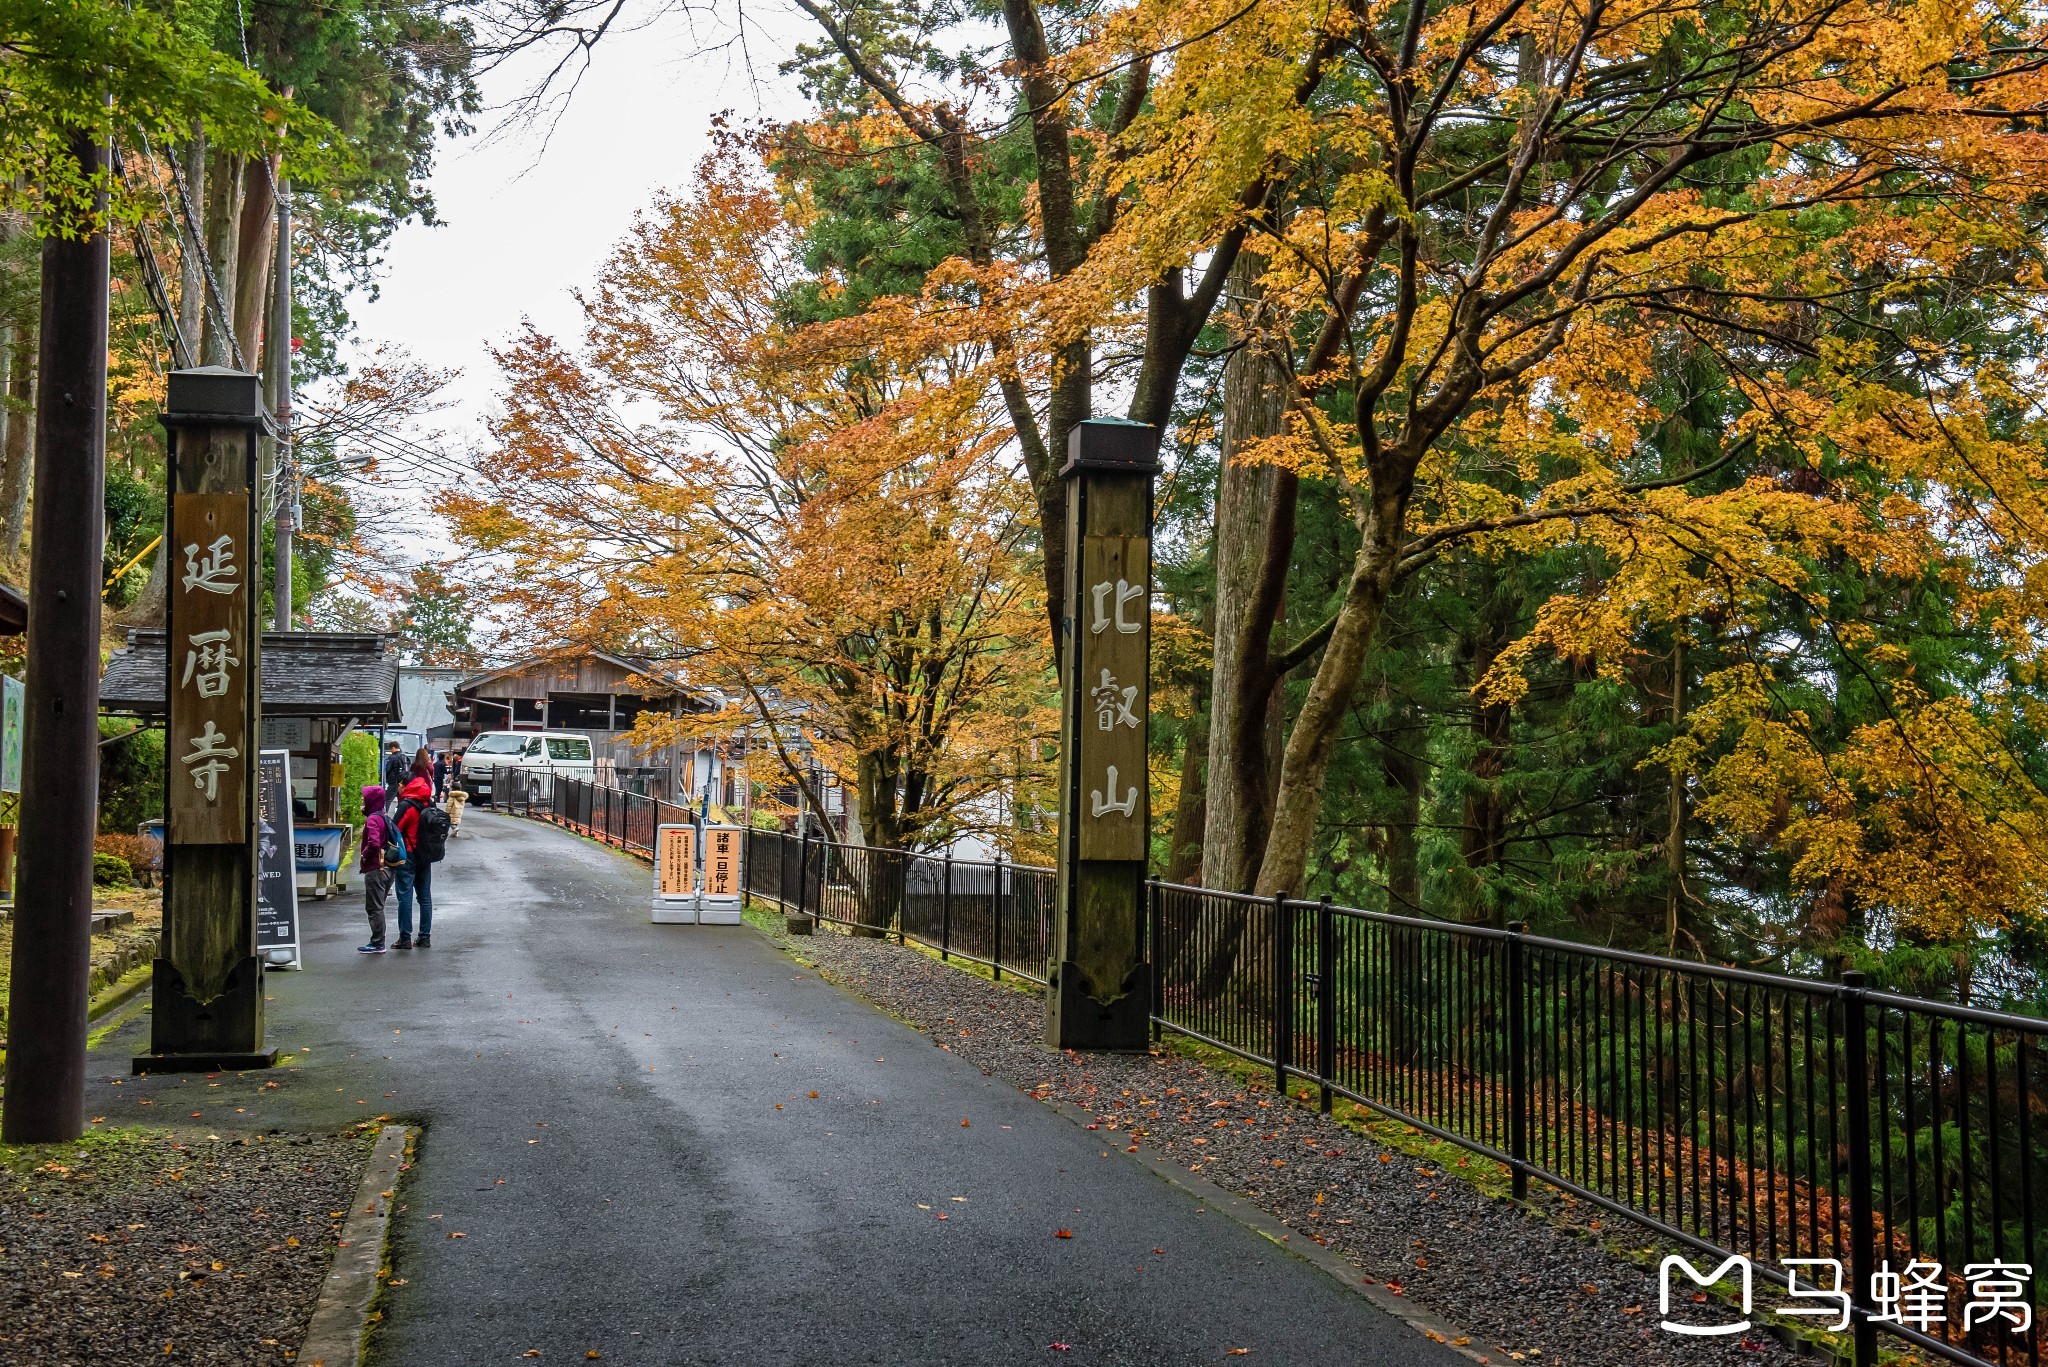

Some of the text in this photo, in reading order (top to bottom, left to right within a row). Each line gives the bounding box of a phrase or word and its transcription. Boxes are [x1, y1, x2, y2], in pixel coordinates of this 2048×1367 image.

[181, 534, 240, 803] 延暦寺
[1090, 578, 1144, 818] 比叡山
[715, 832, 730, 894] 諸車一旦停止
